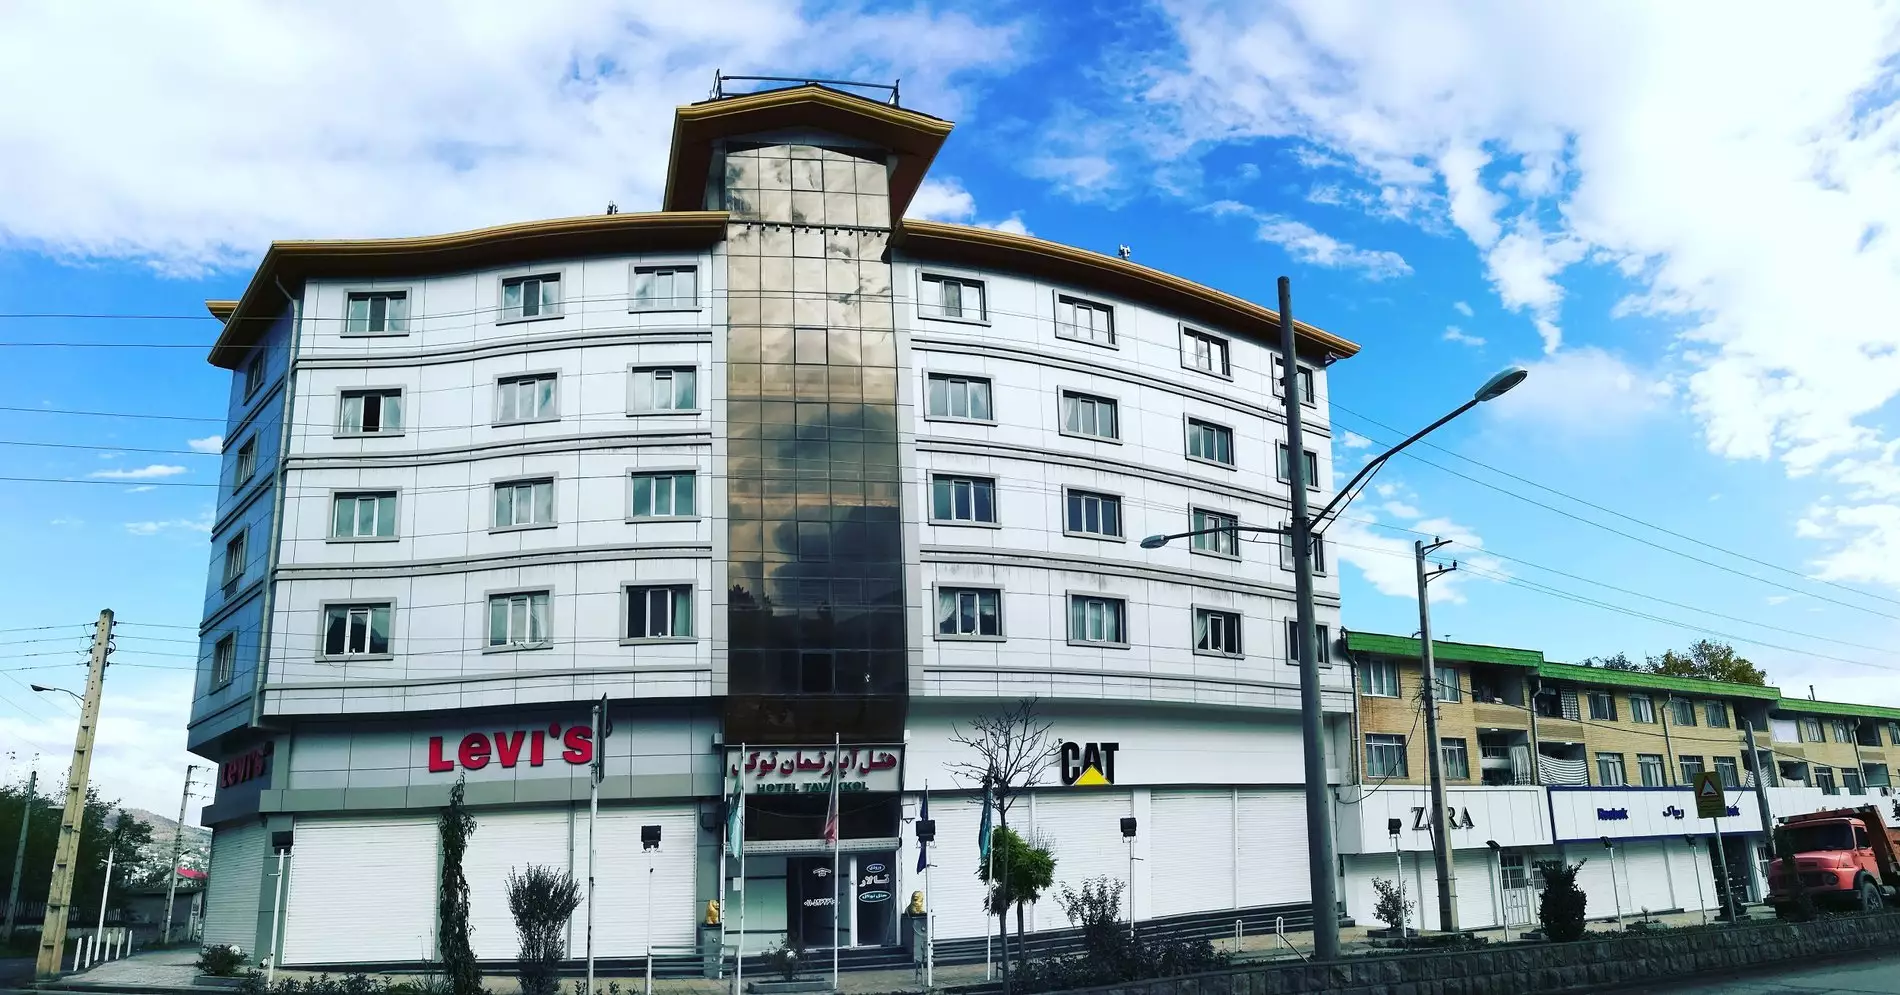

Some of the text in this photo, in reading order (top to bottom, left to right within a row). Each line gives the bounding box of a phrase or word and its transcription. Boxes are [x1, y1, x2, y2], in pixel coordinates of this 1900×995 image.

[780, 749, 858, 778] آپرتمان
[859, 750, 897, 774] هتل
[1061, 741, 1119, 785] CAT
[757, 782, 799, 792] HOTEL
[1411, 807, 1475, 830] ZRA
[1726, 806, 1740, 817] bok
[859, 874, 889, 887] تالار
